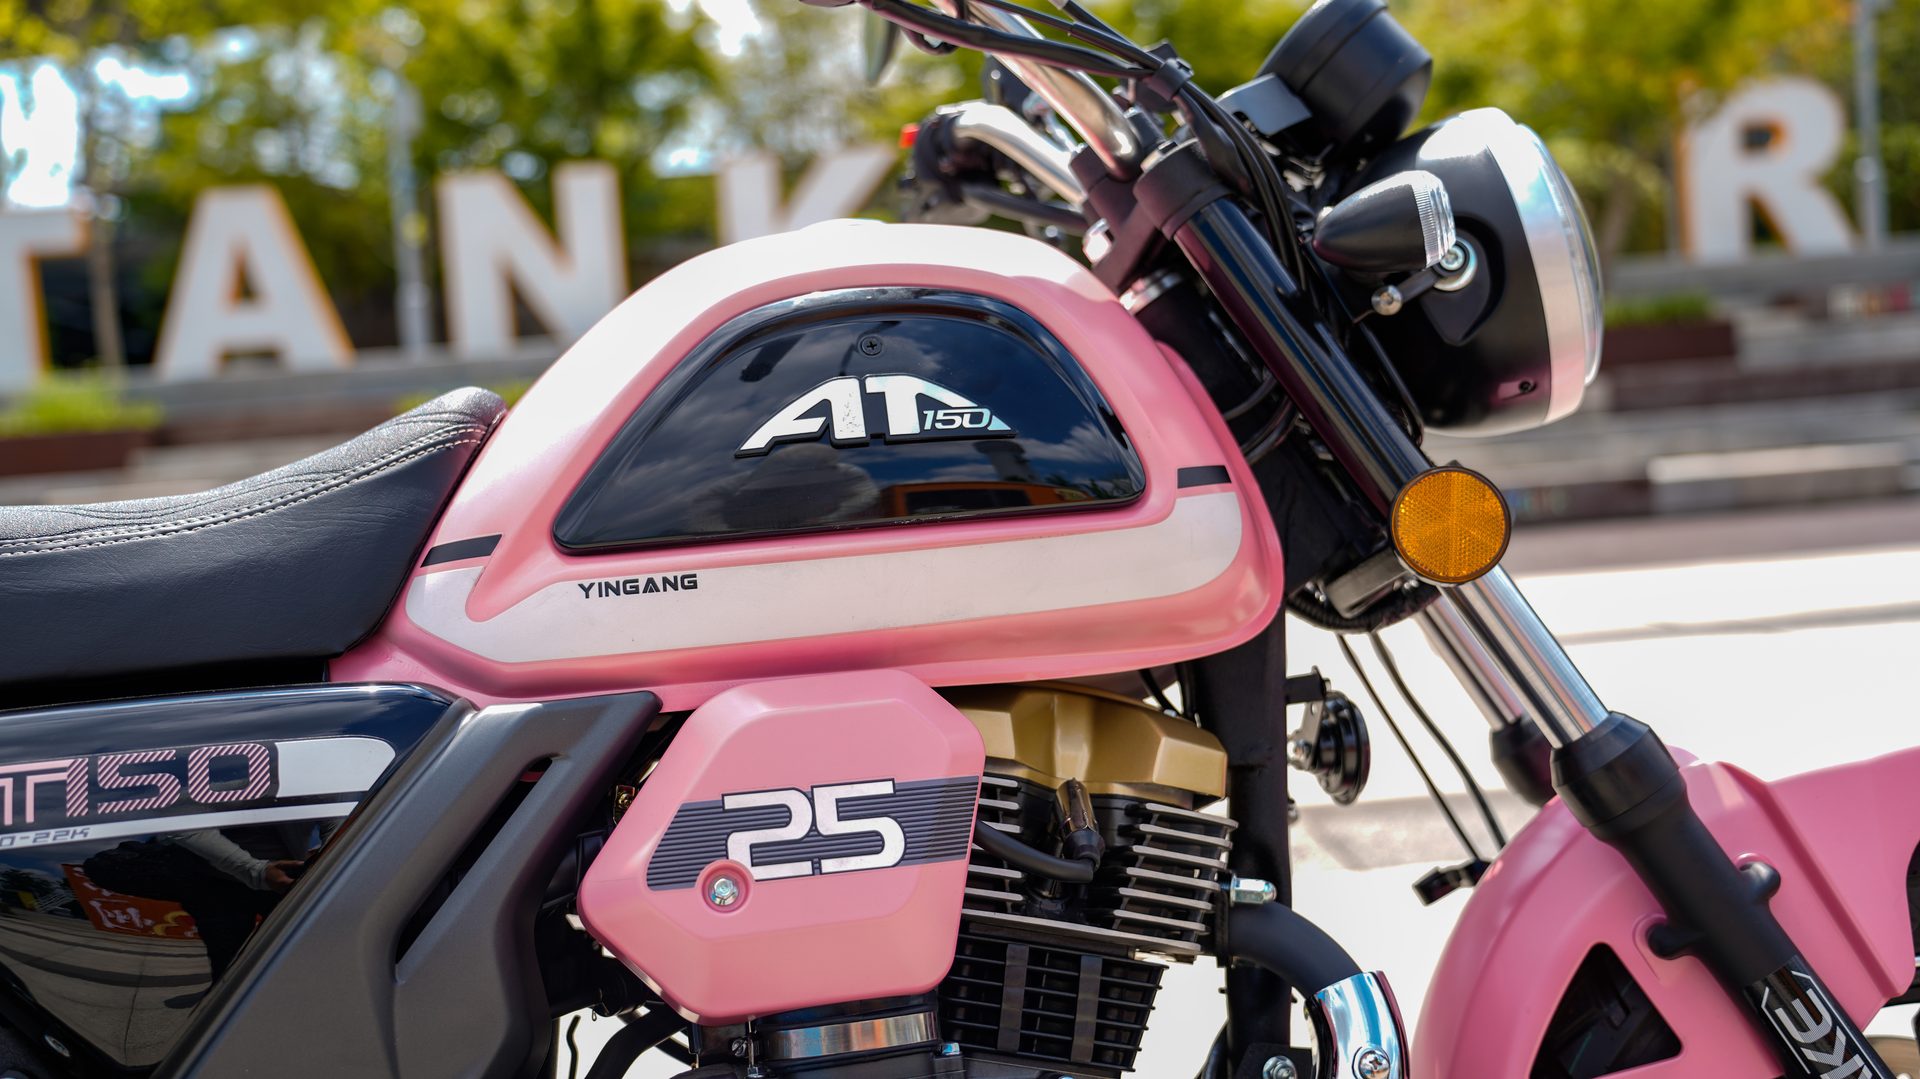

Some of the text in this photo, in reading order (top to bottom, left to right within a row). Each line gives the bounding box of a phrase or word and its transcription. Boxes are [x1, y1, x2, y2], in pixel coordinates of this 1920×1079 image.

[922, 407, 992, 431] 150
[577, 573, 699, 599] YINGANG
[722, 778, 907, 882] 25
